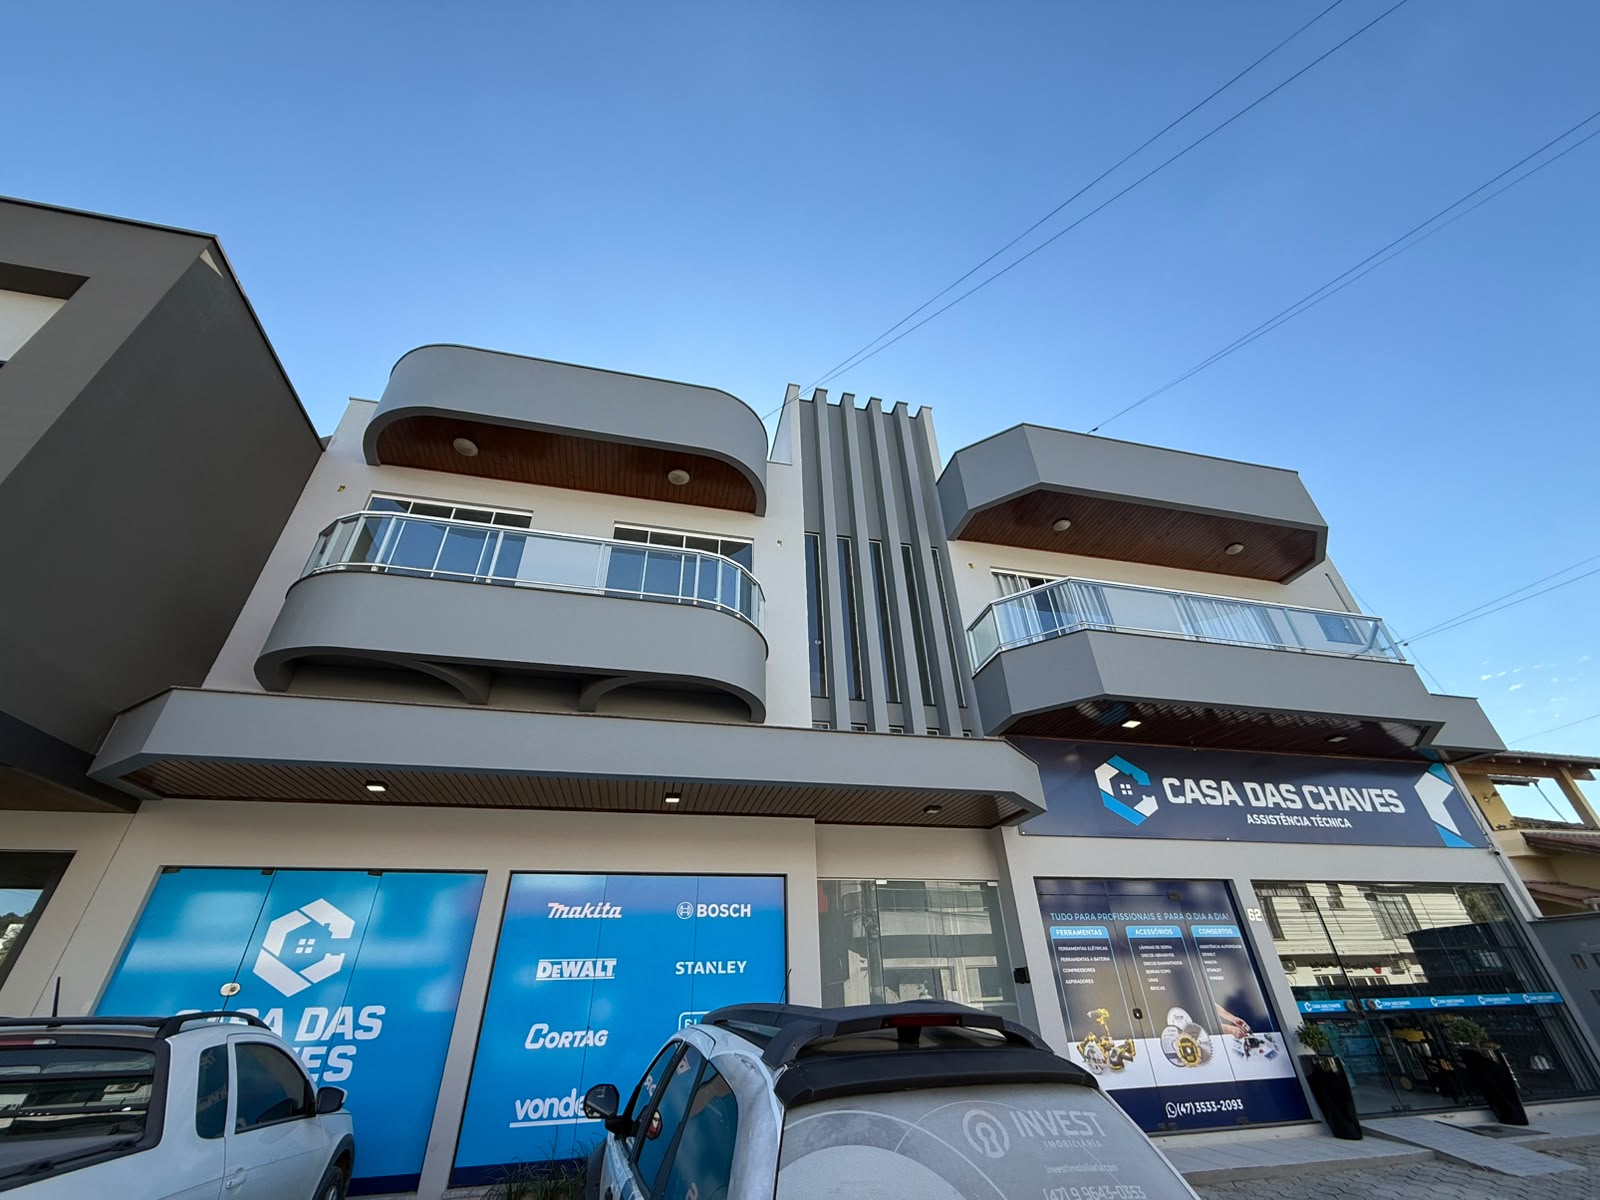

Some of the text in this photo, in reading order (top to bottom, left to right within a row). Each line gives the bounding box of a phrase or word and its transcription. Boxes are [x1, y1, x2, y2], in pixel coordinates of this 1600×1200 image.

[1162, 777, 1406, 813] CASA DAS CHAVES
[1246, 812, 1352, 828] ASSISTÊNCIA TÉCNICA
[696, 903, 751, 918] BOSCH
[1050, 912, 1073, 920] TUDO
[1074, 912, 1097, 920] PARA
[1098, 912, 1156, 920] PROFISSIONAIS
[1157, 912, 1163, 920] E
[1164, 912, 1184, 920] PARA
[1186, 912, 1192, 920] O
[1193, 912, 1208, 920] DIA
[1208, 912, 1214, 920] A
[1247, 908, 1262, 921] 62
[675, 961, 747, 975] STANLEY
[295, 1005, 386, 1041] DAS
[515, 1088, 586, 1120] vonde
[1177, 1099, 1243, 1116] (47) 3533-2093
[1009, 1110, 1107, 1137] INVEST
[1070, 1187, 1082, 1200] 9
